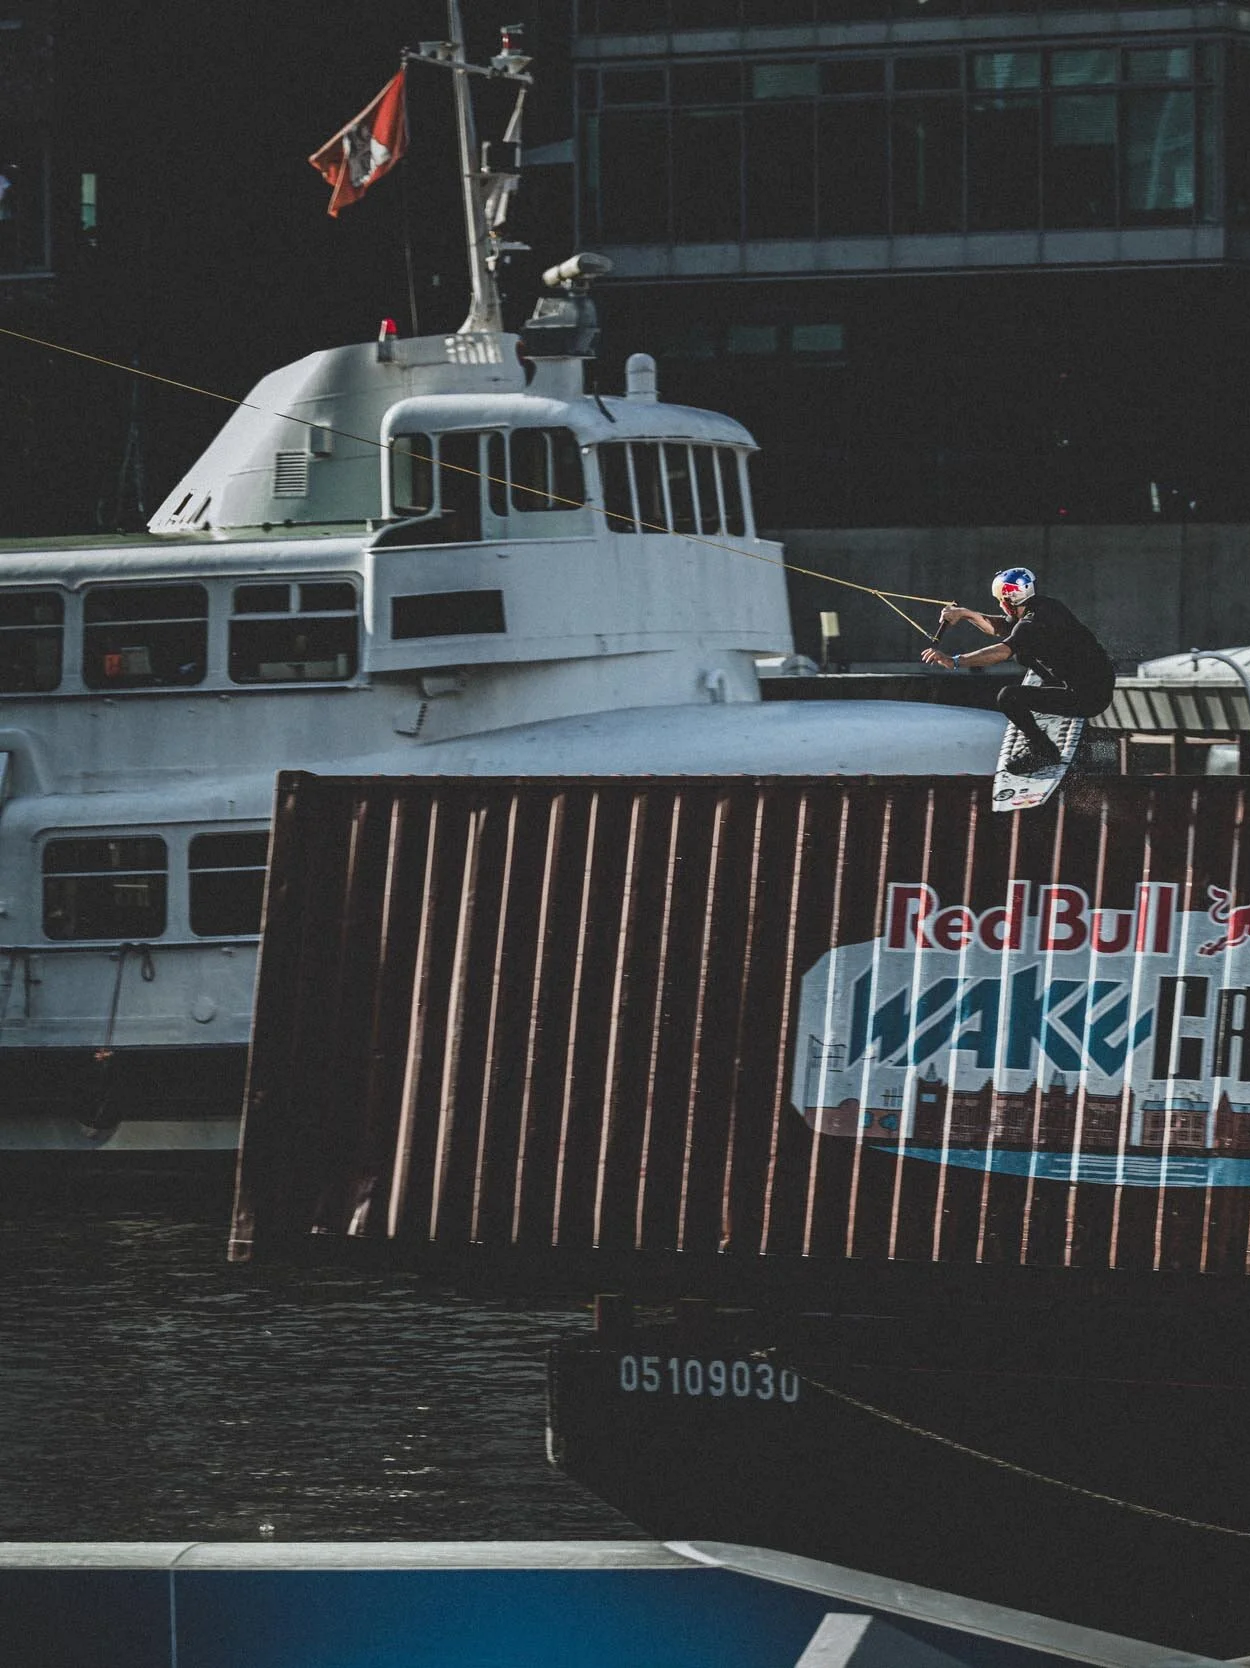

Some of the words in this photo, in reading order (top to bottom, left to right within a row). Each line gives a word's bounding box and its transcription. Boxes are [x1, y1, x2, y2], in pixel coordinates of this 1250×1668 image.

[887, 882, 1031, 952] Red
[1039, 882, 1180, 955] Bull
[620, 1355, 800, 1403] 05109030
